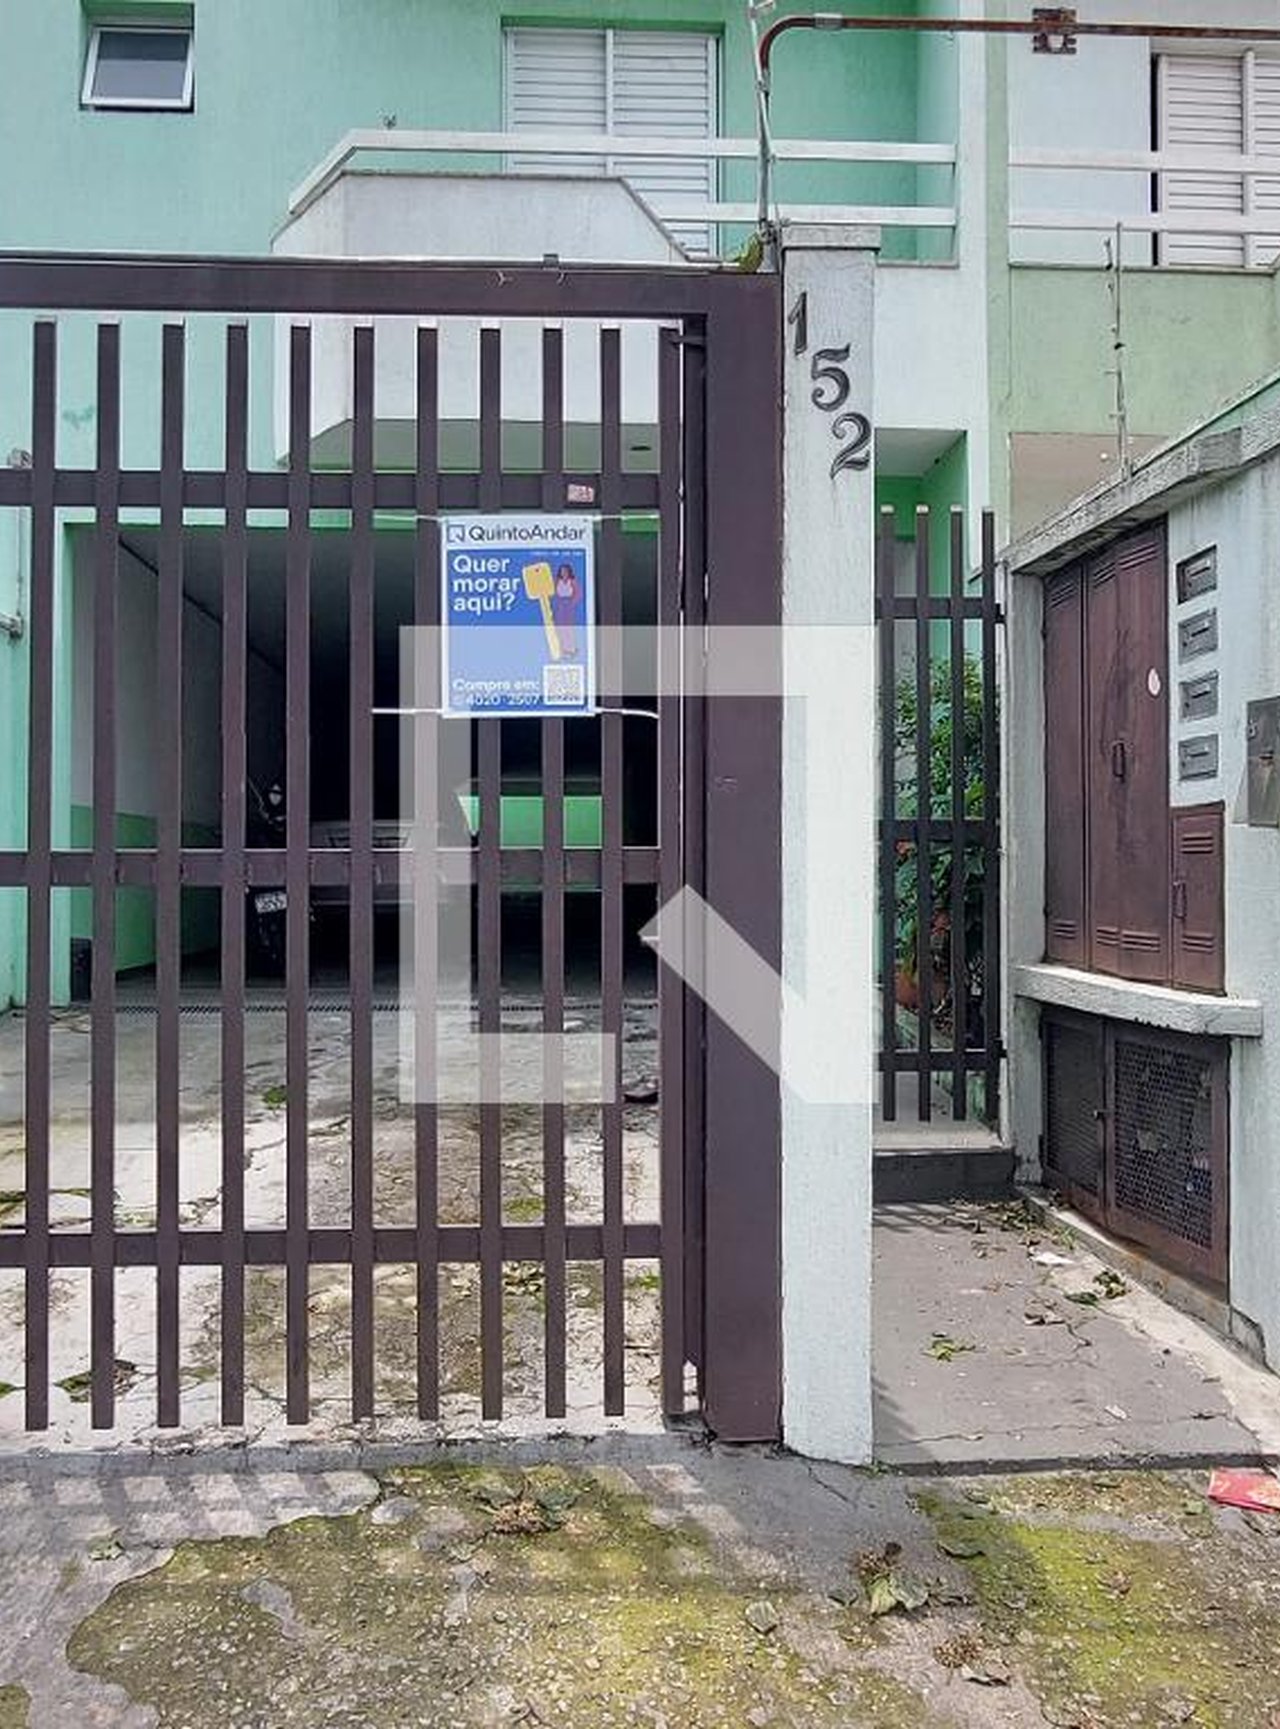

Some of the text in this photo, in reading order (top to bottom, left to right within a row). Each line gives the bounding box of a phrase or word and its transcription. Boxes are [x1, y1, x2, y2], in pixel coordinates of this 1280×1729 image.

[788, 291, 871, 480] 152
[468, 525, 585, 541] QuintoAndar
[452, 555, 510, 573] Quer
[453, 578, 520, 593] morar
[453, 592, 516, 616] aqui?
[452, 679, 511, 693] Compre
